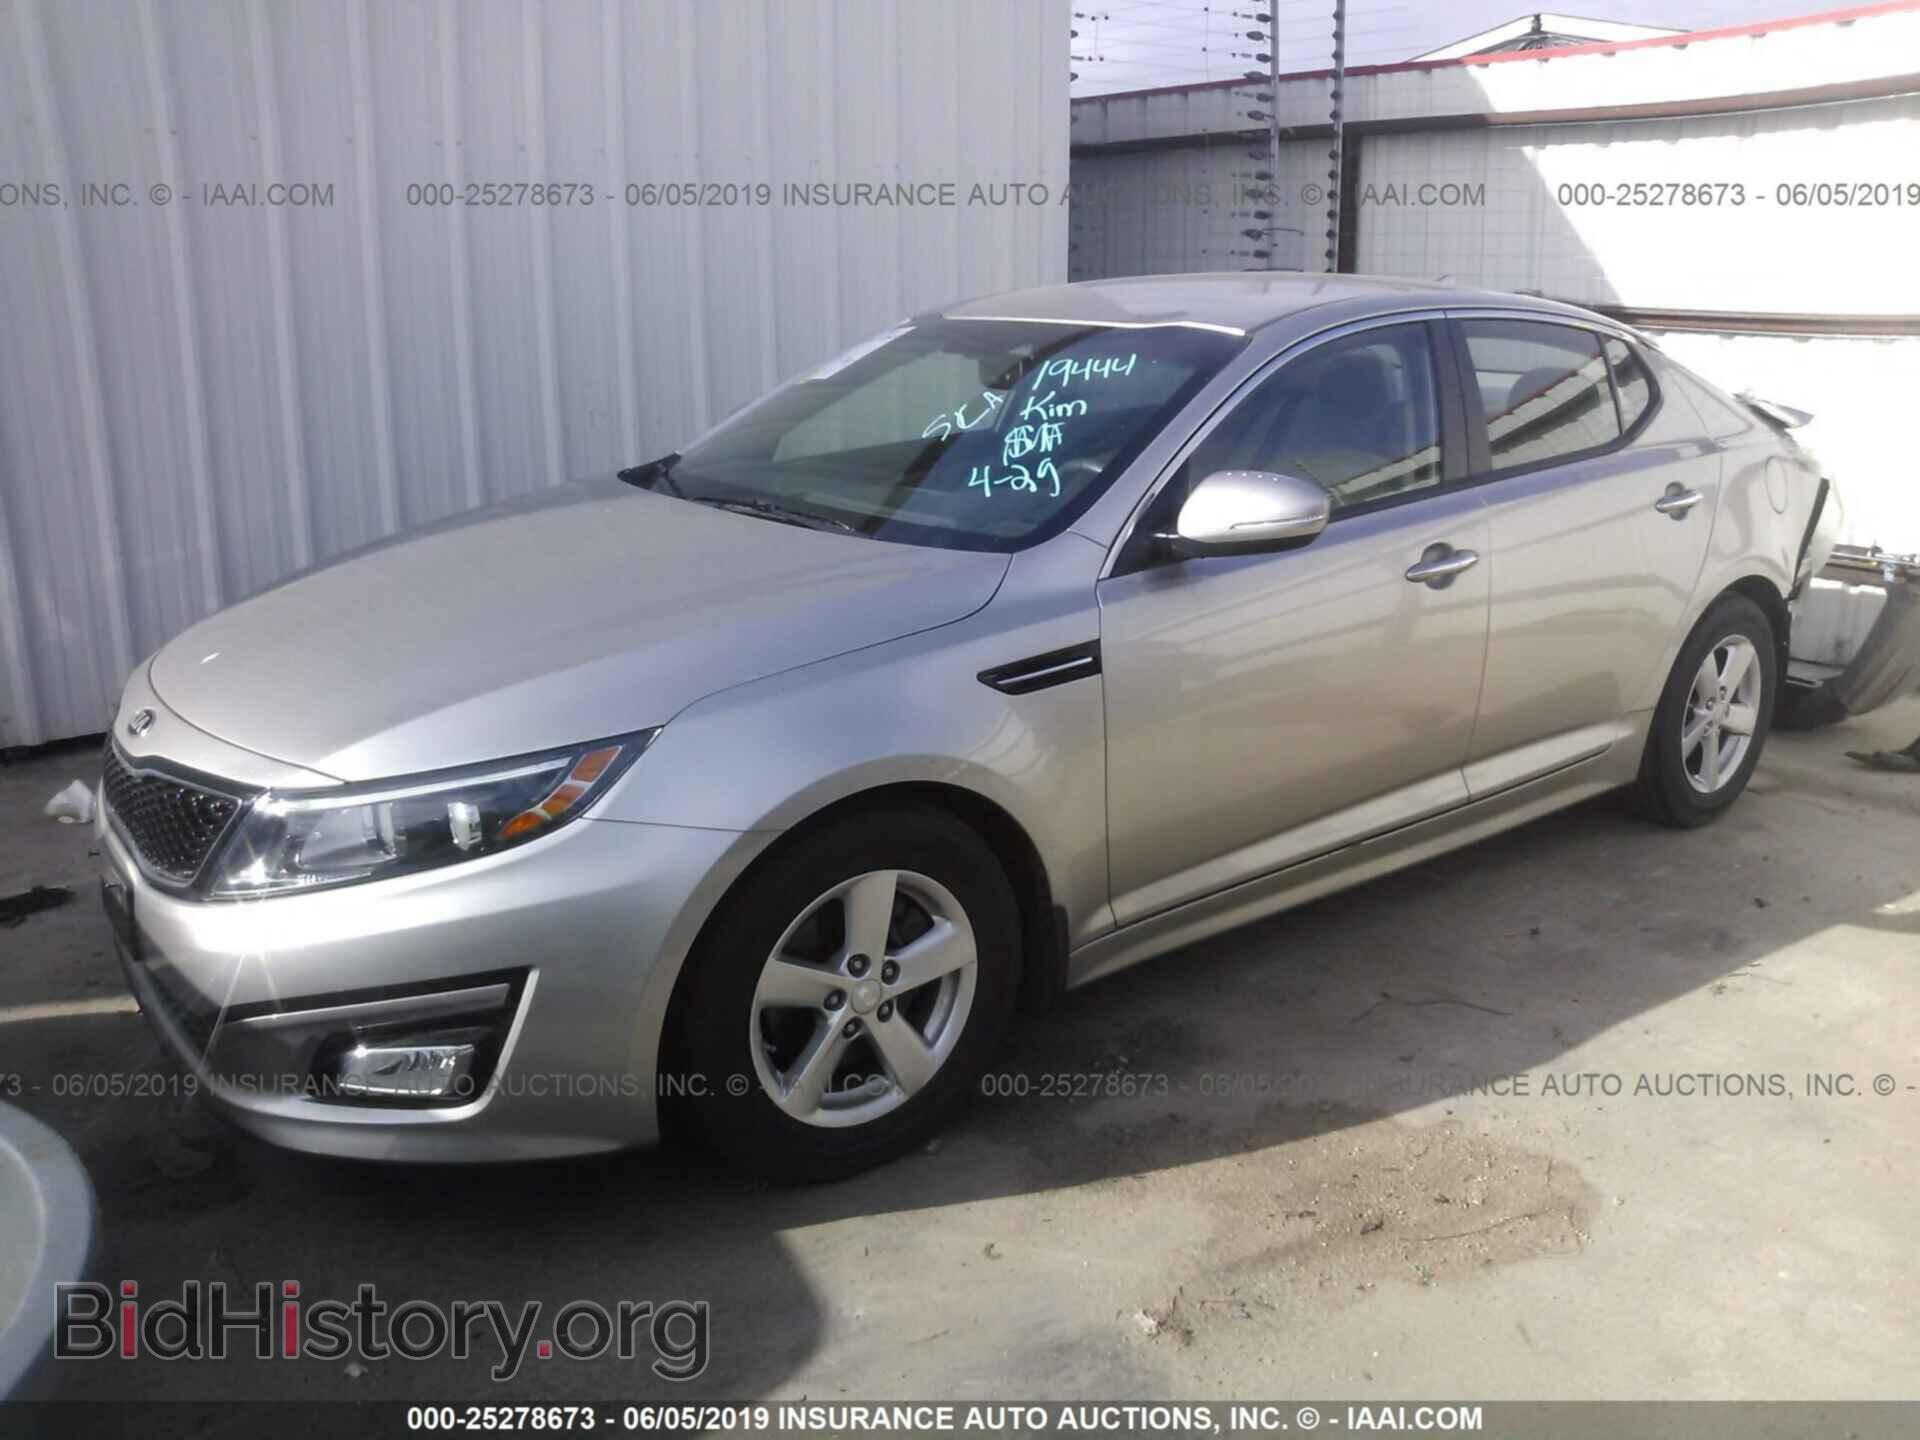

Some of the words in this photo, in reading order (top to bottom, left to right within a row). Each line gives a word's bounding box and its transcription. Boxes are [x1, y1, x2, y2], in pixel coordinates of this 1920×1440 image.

[1031, 353, 1138, 391] 19444
[1019, 391, 1088, 420] Kim
[967, 457, 1061, 498] 4-29
